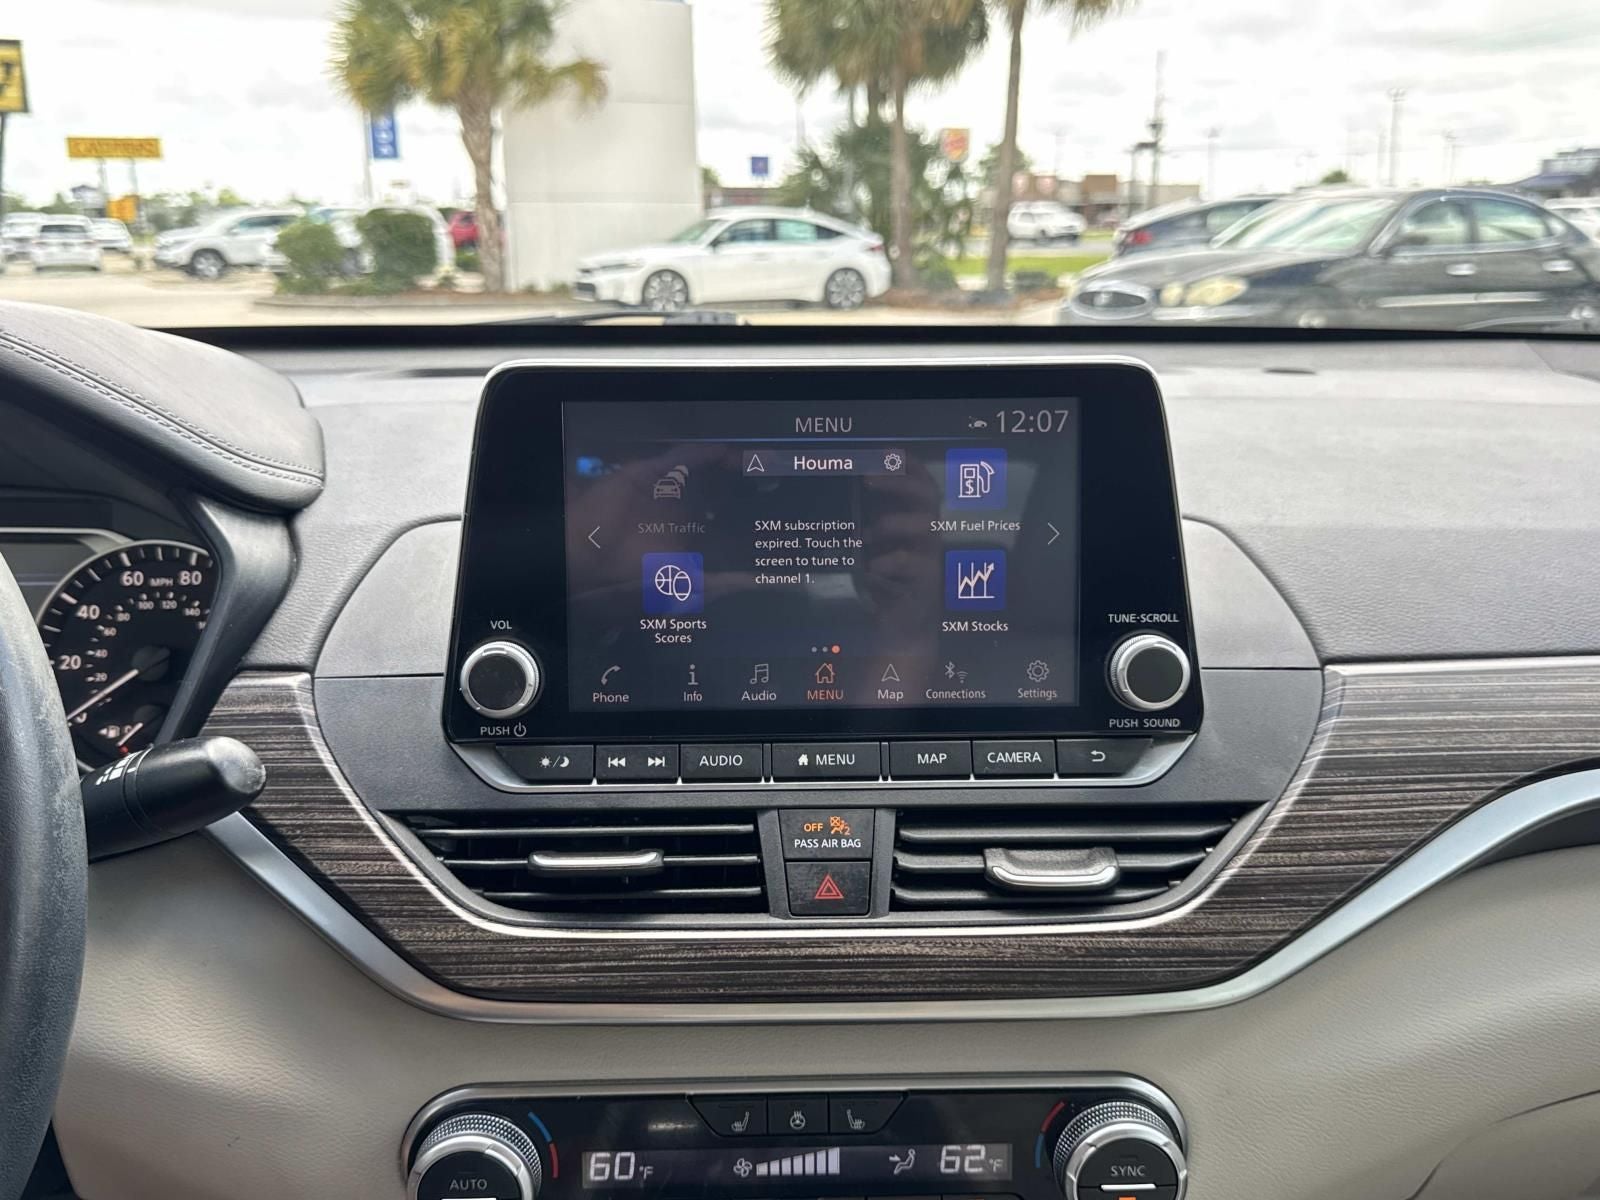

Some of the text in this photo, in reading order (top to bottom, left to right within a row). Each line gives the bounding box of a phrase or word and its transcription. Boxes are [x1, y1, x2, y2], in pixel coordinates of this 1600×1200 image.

[795, 417, 852, 433] MENU
[996, 410, 1069, 433] 12:07
[794, 456, 853, 470] Houma
[637, 523, 705, 534] SXM Traffic
[754, 520, 855, 532] SXM subscription
[930, 519, 1021, 531] SXM Fuel Prices
[754, 537, 863, 550] expired. Touch the
[754, 557, 855, 566] screen to tune to
[122, 571, 202, 586] 60 MPH 80
[755, 573, 815, 584] channel 1.
[78, 605, 100, 619] 40
[490, 620, 512, 630] VOL
[640, 618, 707, 632] SXM Sports
[942, 621, 1009, 632] SXM Stocks
[655, 634, 692, 644] Scores
[59, 656, 82, 670] 20
[593, 693, 630, 703] Phone
[684, 692, 703, 702] Info
[742, 691, 777, 701] Audio
[807, 689, 844, 700] MENU
[877, 689, 904, 701] Map
[926, 689, 986, 699] Connections
[1018, 688, 1058, 701] Settings
[1109, 718, 1181, 728] PUSH SOUND
[480, 726, 510, 736] PUSH
[699, 755, 743, 767] AUDIO
[816, 754, 855, 765] MENU
[917, 753, 947, 764] MAP
[987, 752, 1042, 764] CAMERA
[803, 822, 823, 833] OFF
[794, 838, 861, 849] PASS AIR BAG
[1110, 1164, 1146, 1177] SYNC
[449, 1178, 488, 1191] AUTO
